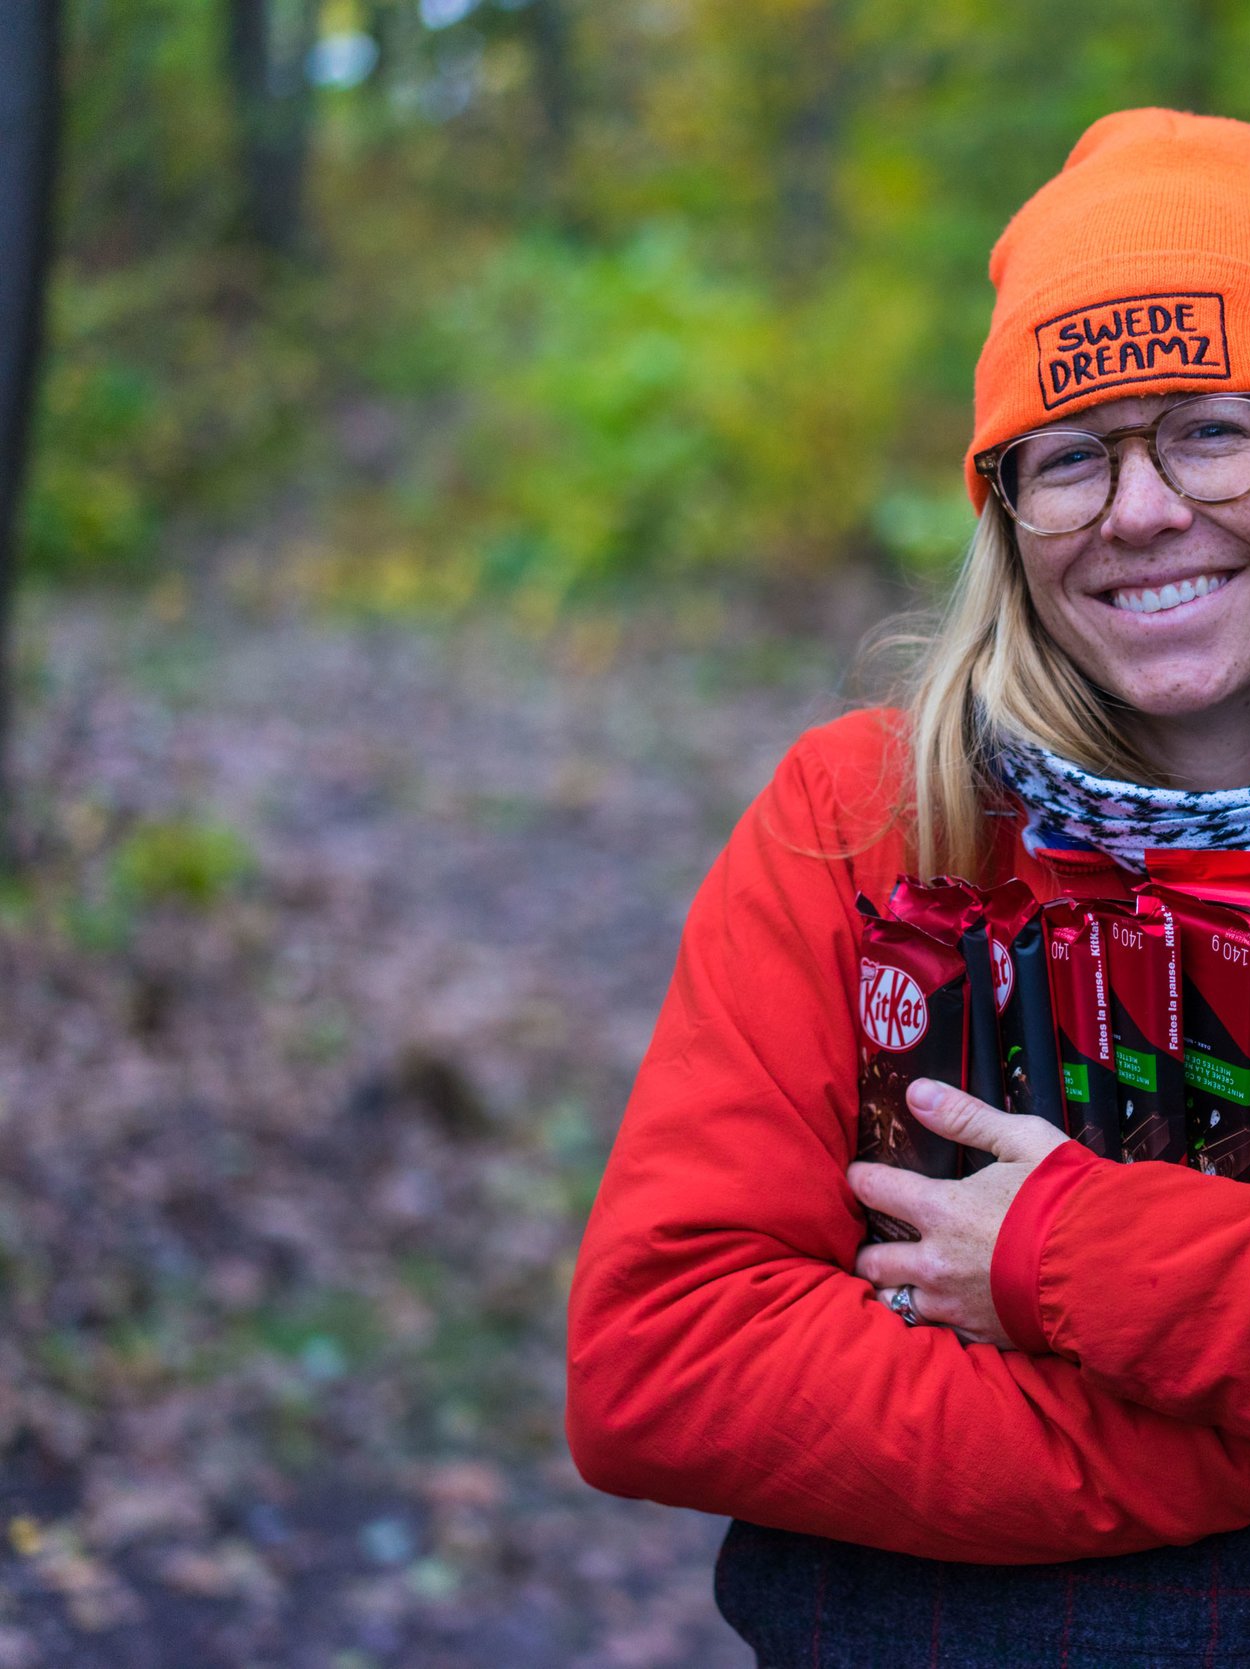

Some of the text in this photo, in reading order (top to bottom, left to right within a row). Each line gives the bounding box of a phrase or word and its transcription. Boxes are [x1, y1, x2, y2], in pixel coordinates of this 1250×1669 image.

[1057, 304, 1197, 352] SWEDE
[1049, 336, 1220, 394] DREAMZ
[1089, 921, 1101, 957] KitKat
[1112, 922, 1143, 950] 140 g
[1163, 912, 1175, 947] KitKat
[1211, 934, 1220, 952] g
[1051, 941, 1070, 961] 140
[1223, 942, 1249, 966] 140
[863, 968, 924, 1046] KitKat
[1097, 1010, 1106, 1021] la
[1168, 1001, 1177, 1011] la
[1098, 1024, 1109, 1060] Faites
[1169, 1014, 1178, 1050] Faites
[1227, 1087, 1245, 1099] MINT
